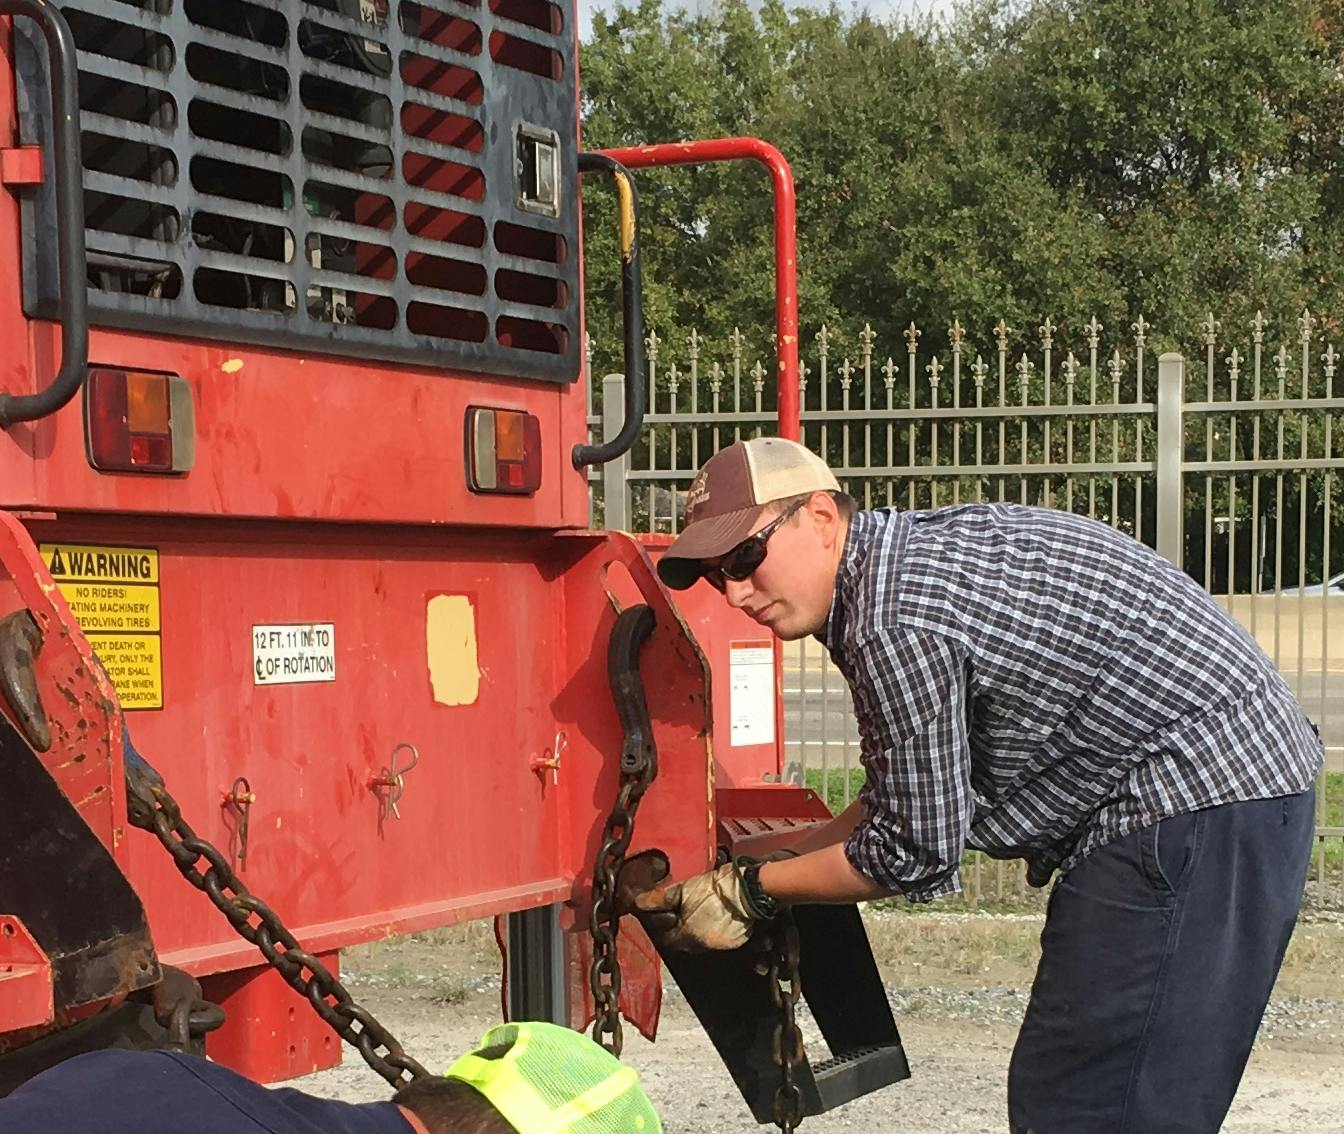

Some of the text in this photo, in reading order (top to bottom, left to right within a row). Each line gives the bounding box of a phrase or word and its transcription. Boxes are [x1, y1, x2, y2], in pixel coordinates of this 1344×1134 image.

[67, 552, 151, 579] WARNING
[76, 588, 89, 598] NO
[99, 603, 150, 613] MACHINERY
[125, 617, 150, 628] TIRES
[255, 632, 266, 649] 12
[269, 632, 284, 648] FT.
[286, 632, 297, 648] 11
[316, 630, 330, 647] TO
[109, 641, 133, 650] DEATH
[135, 642, 145, 650] OR
[119, 655, 138, 663] ONLY
[140, 655, 154, 663] THE
[266, 658, 280, 675] OF
[283, 656, 334, 675] ROTATION
[127, 667, 150, 676] SHALL
[132, 680, 154, 689] WHEN
